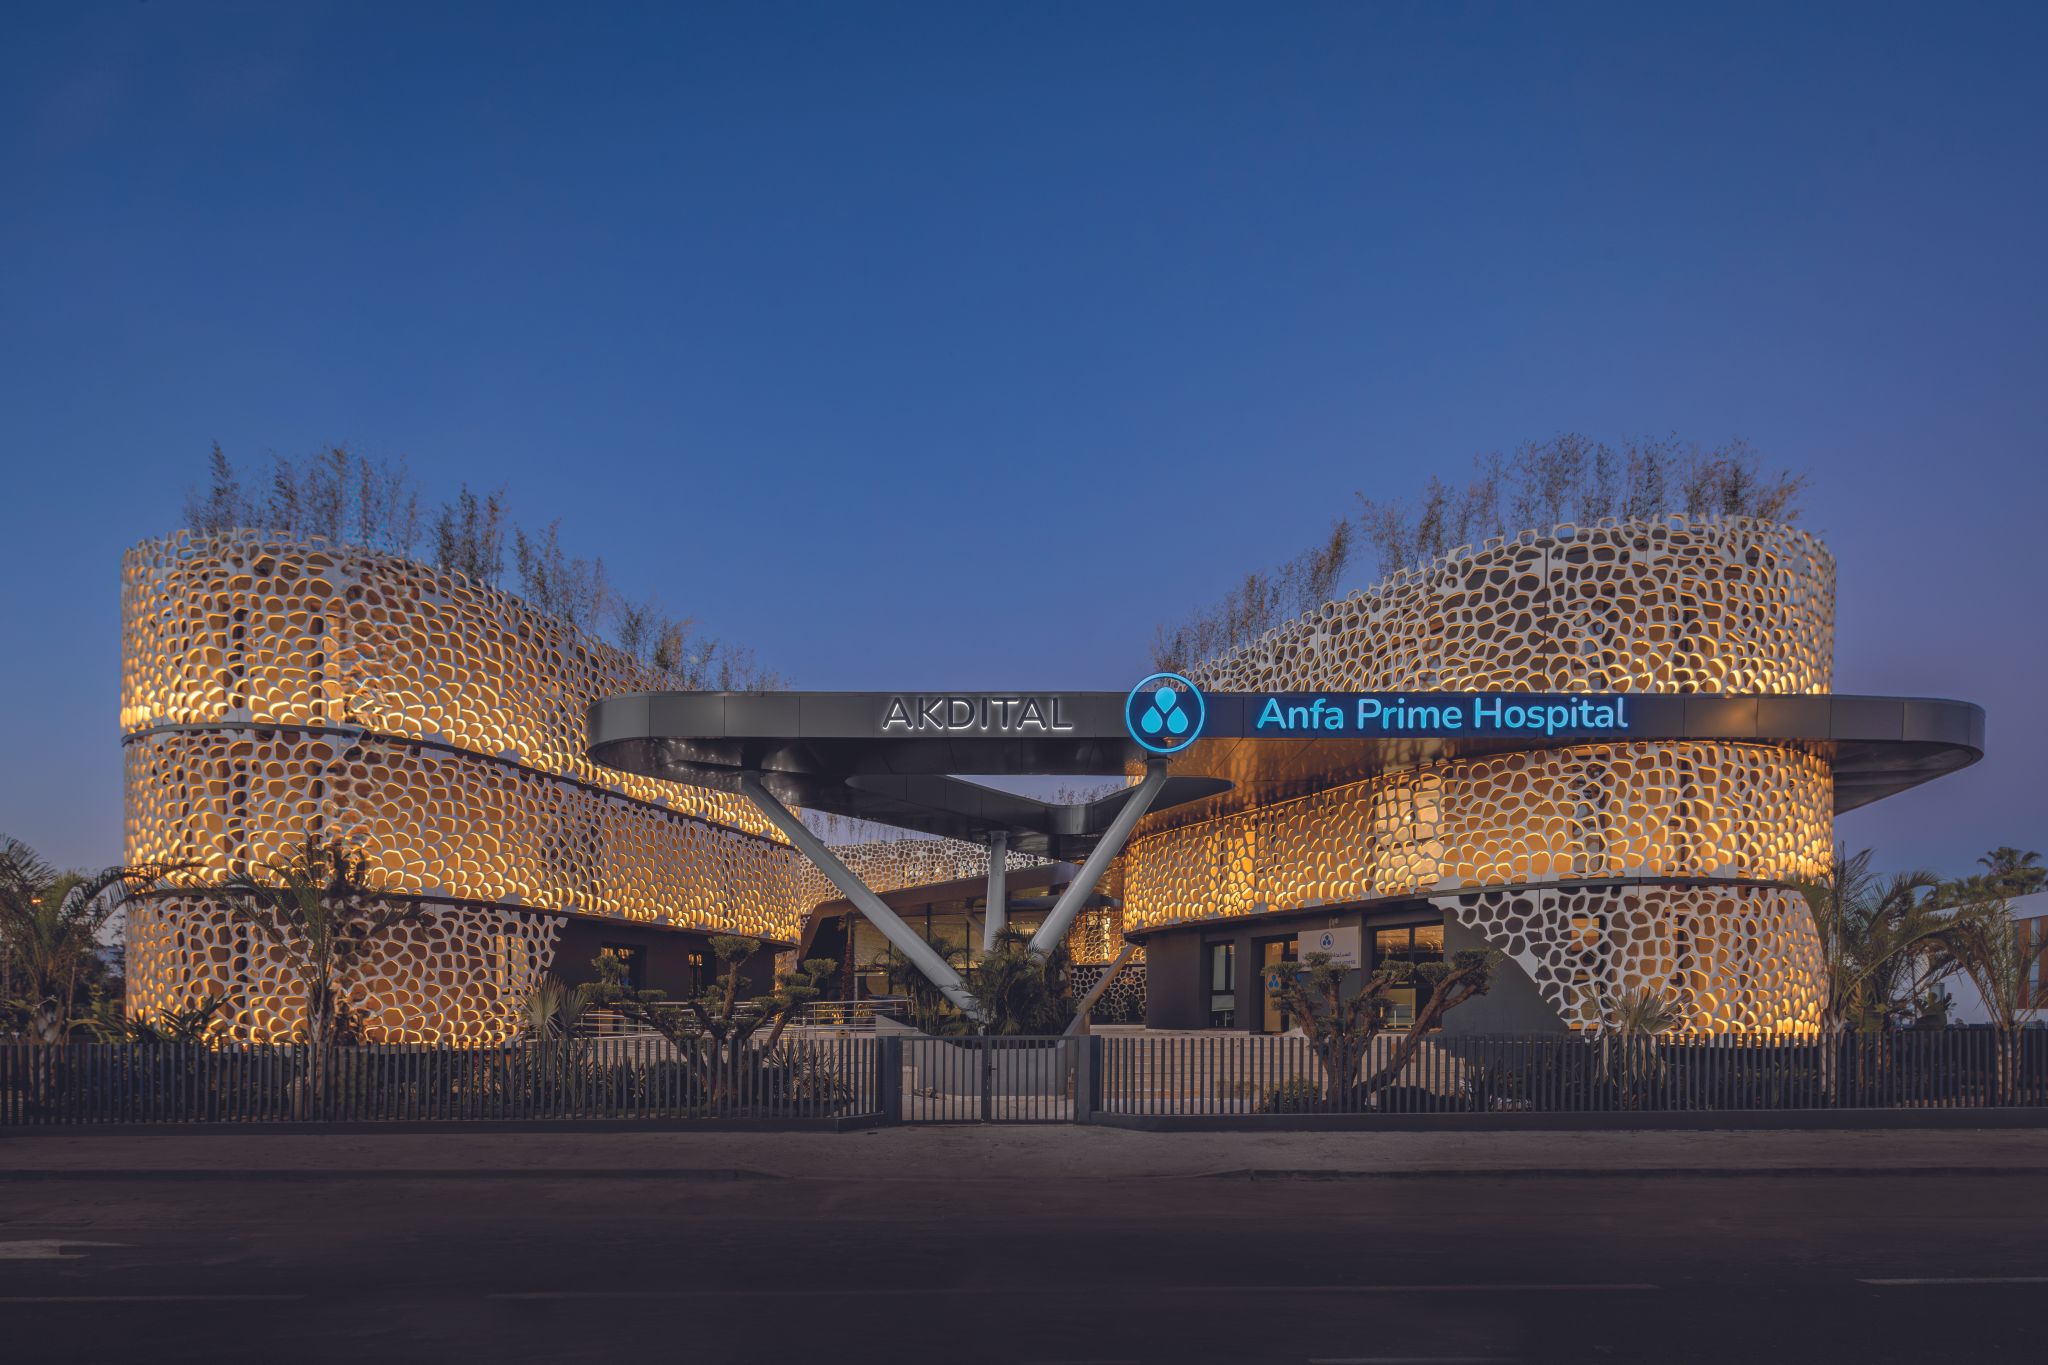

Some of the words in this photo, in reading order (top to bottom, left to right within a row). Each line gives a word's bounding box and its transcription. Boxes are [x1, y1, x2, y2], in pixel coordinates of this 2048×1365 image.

[882, 696, 1074, 730] AKDITAL
[1256, 697, 1344, 730] Anfa
[1357, 697, 1463, 730] Prime
[1474, 696, 1629, 736] Hospital
